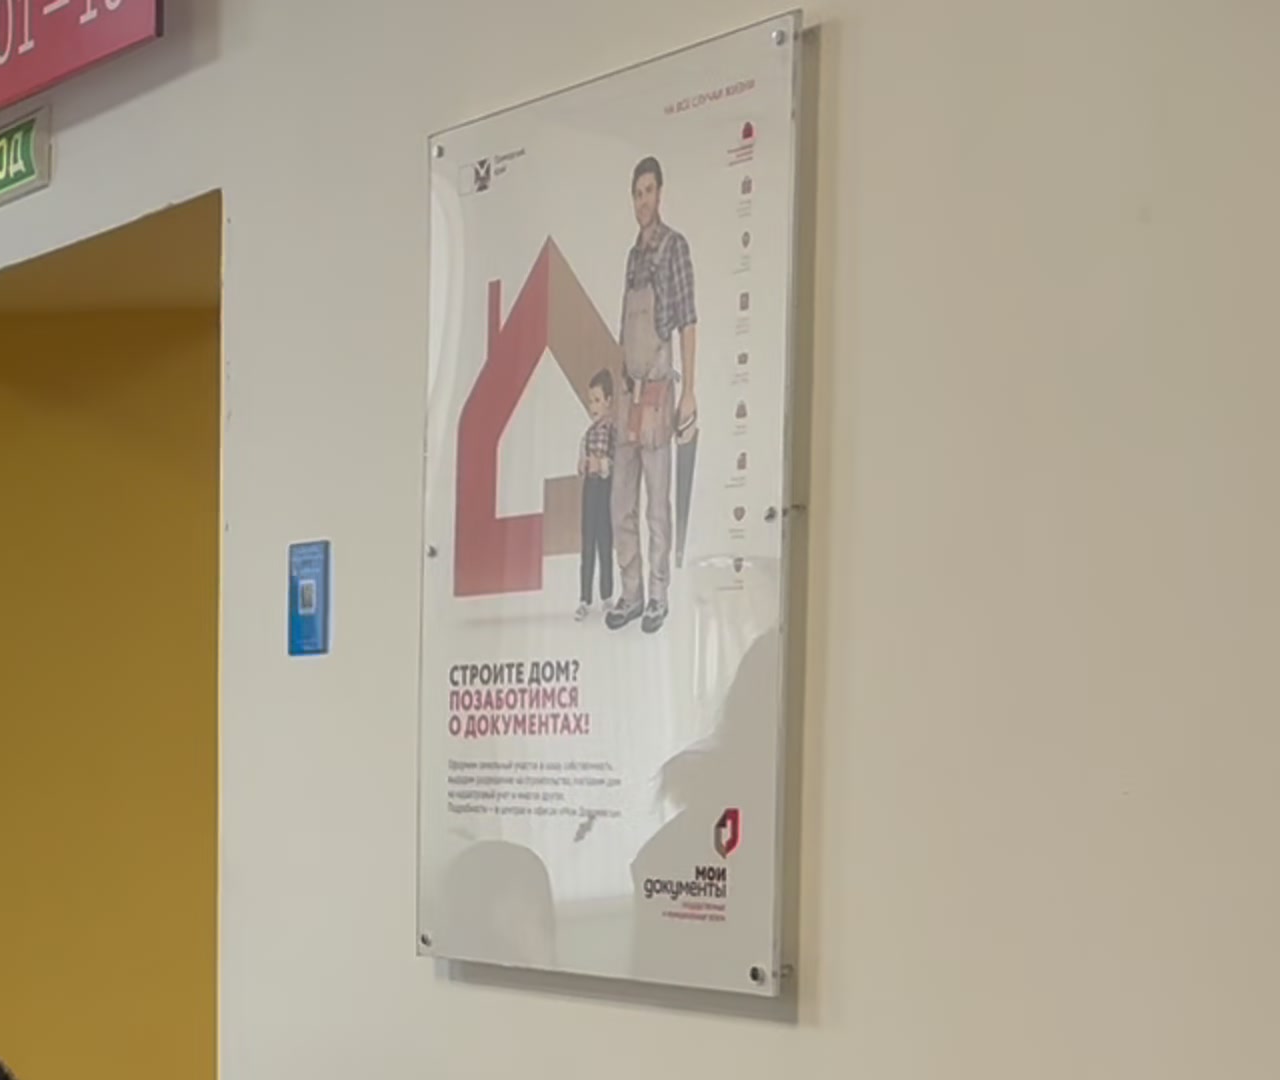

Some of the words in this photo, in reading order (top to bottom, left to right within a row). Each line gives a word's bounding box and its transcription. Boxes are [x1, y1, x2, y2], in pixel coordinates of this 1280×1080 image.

[449, 662, 525, 687] СТРОИТЕ
[527, 658, 580, 687] ДОМ?
[449, 686, 579, 711] ПОЗАБОТИМСЯ
[448, 714, 461, 736] О
[464, 712, 590, 739] ДОКУМЕНТАХ!
